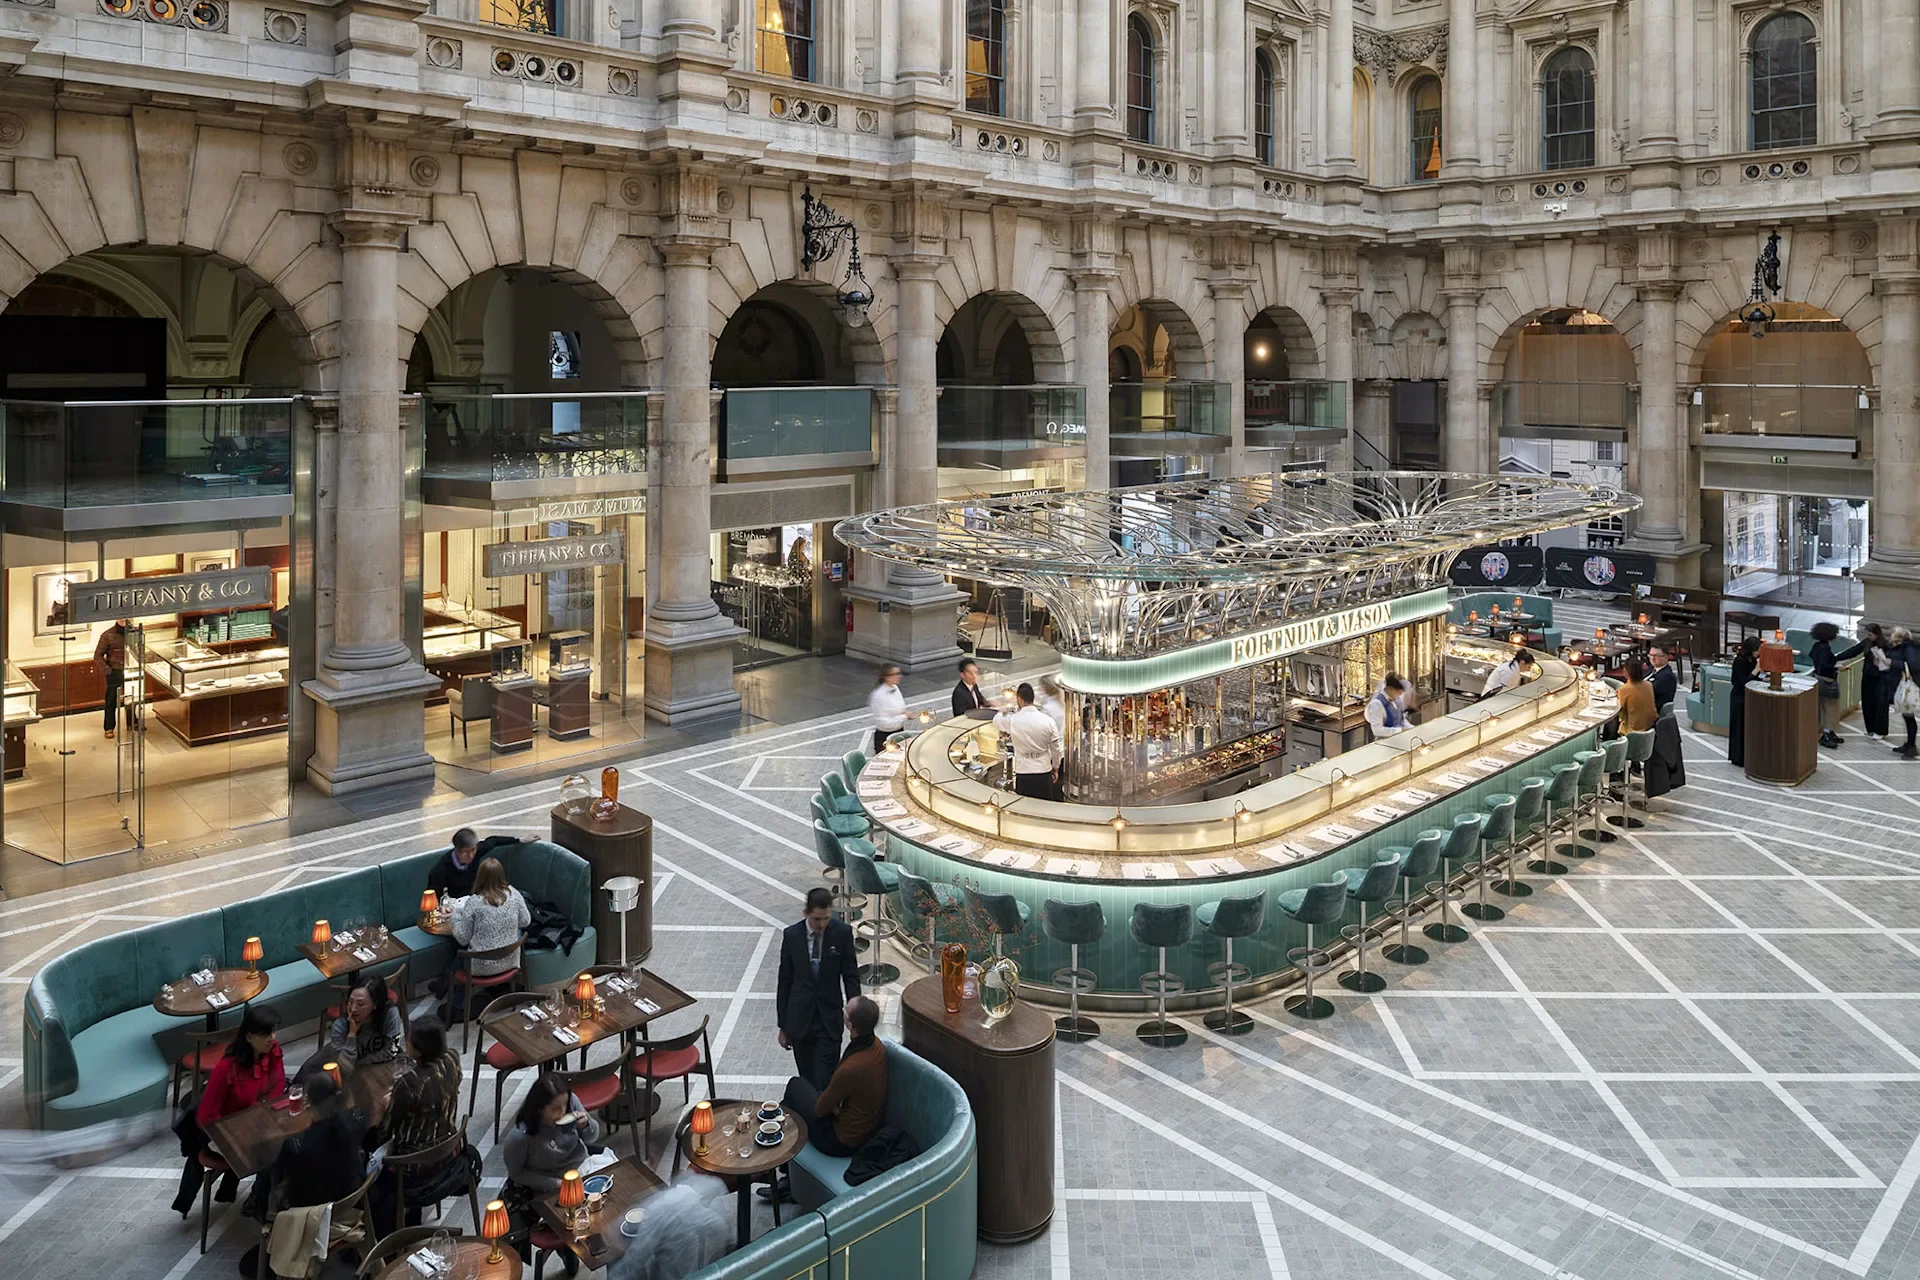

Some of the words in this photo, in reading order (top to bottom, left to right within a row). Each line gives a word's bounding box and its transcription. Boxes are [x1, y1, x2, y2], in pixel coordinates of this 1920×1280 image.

[499, 545, 572, 568] TIFFANY
[575, 544, 587, 560] &
[88, 583, 194, 612] TIFFANY
[198, 581, 216, 602] &
[1231, 620, 1322, 663] FORTNUM
[1325, 617, 1338, 638] &
[1340, 602, 1393, 635] MASON
